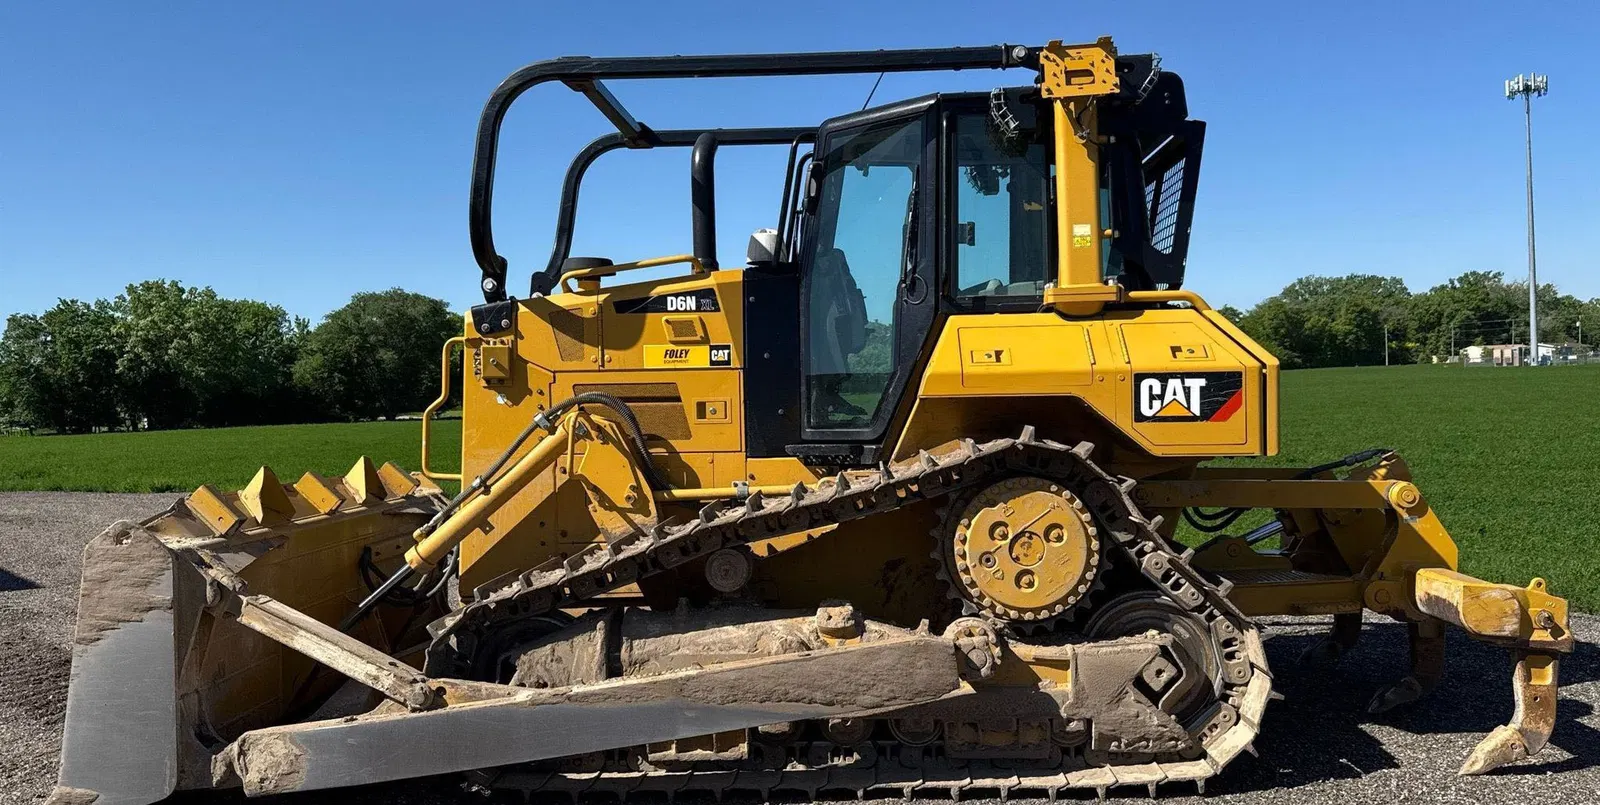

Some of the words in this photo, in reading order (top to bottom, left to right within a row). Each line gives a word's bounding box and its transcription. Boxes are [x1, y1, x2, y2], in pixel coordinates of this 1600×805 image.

[667, 296, 696, 311] D6N
[701, 299, 715, 310] XL
[664, 349, 690, 359] FOLEY
[711, 350, 730, 361] CAT
[1140, 378, 1206, 417] CAT
